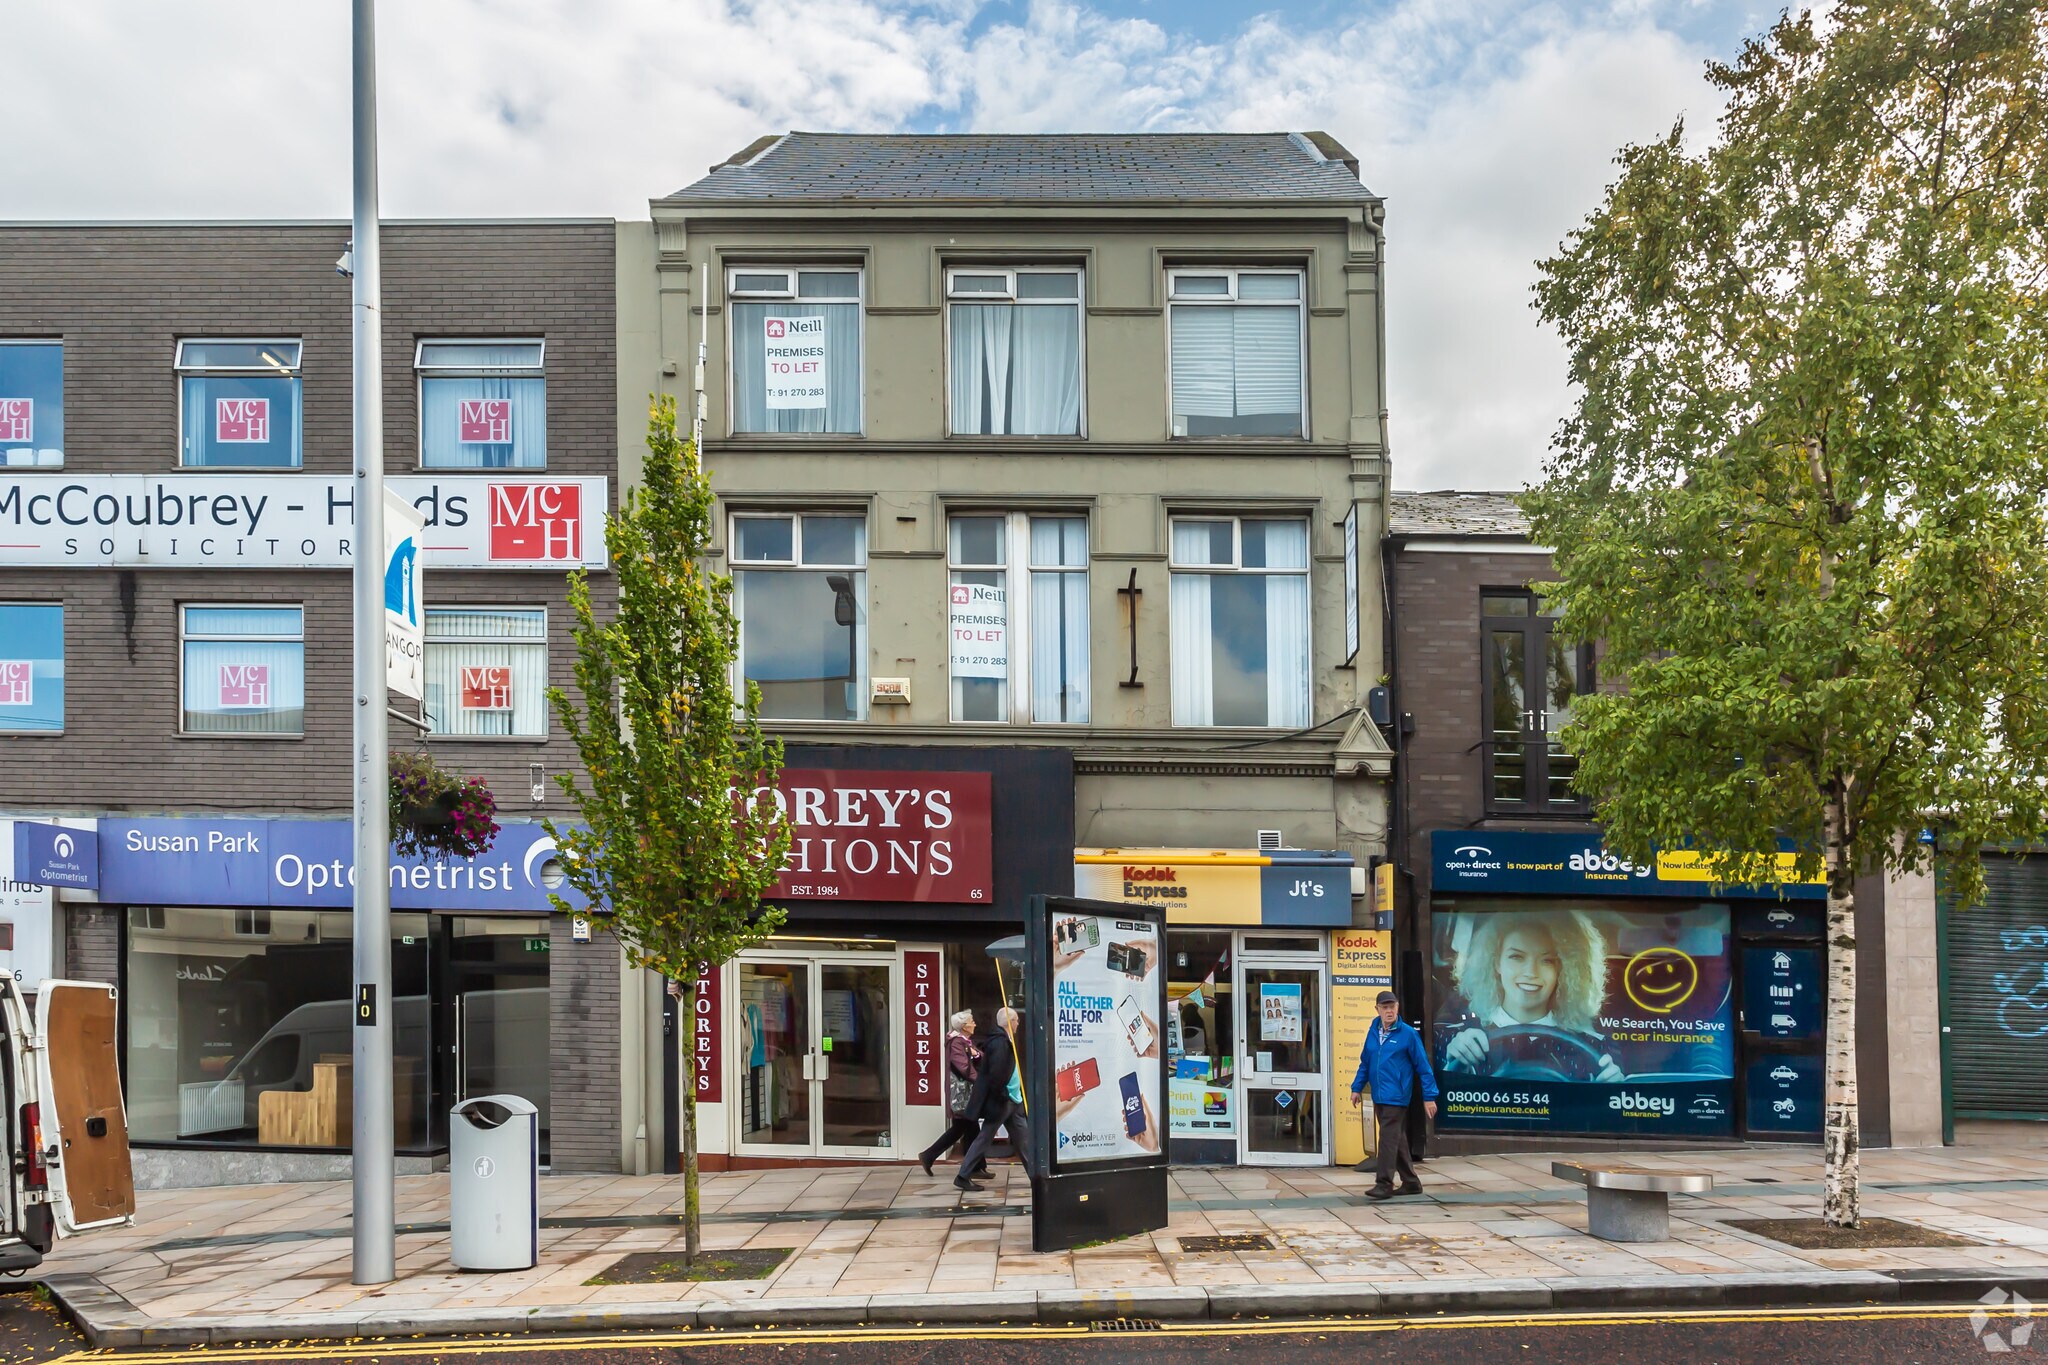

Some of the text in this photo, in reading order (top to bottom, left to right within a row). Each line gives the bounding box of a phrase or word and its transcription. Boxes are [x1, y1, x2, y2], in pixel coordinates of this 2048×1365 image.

[788, 320, 822, 333] Neill
[767, 347, 824, 357] PREMISES
[771, 362, 819, 374] TO LET
[767, 389, 776, 397] T:
[778, 389, 788, 397] 91
[809, 388, 824, 396] 283
[0, 485, 268, 535] McCoubrey
[327, 485, 468, 527] Hds
[65, 538, 353, 556] SOLICITOR
[973, 587, 1006, 602] Neill
[951, 614, 1006, 626] PREMISES
[954, 629, 1002, 641] TO LET
[385, 630, 422, 662] ANGOR
[960, 656, 970, 664] 91
[972, 656, 988, 664] 270
[990, 657, 1006, 666] 283
[127, 830, 260, 853] Susan Park
[48, 861, 80, 871] Susan Park
[1507, 861, 1515, 869] is
[1535, 863, 1549, 871] part
[1551, 862, 1564, 870] of
[41, 869, 88, 883] Optometrist
[275, 854, 513, 895] Optmetrist
[1123, 866, 1176, 881] Kodak
[1585, 872, 1628, 880] insurance
[791, 885, 839, 896] EST. 1984
[970, 889, 983, 899] 65
[1123, 882, 1188, 901] Express
[1289, 880, 1324, 898] Jt's
[1151, 901, 1188, 909] Solutions
[1336, 936, 1378, 949] Kodak
[1337, 949, 1387, 963] Express
[1337, 962, 1387, 970] Digital Solutions
[1336, 976, 1347, 984] Tel:
[1360, 977, 1375, 985] 9185
[1376, 977, 1390, 985] 7888
[1058, 981, 1078, 995] ALL
[1058, 995, 1113, 1009] TOGETHER
[1059, 1009, 1103, 1023] ALL FOR
[914, 963, 931, 1093] STOREYS
[1059, 1023, 1083, 1037] FREE
[1600, 1017, 1725, 1031] We Search, You Save
[1612, 1032, 1714, 1044] on car insurance
[1447, 1091, 1549, 1105] 08000 66 55 44
[1609, 1091, 1675, 1115] abbey
[1169, 1105, 1196, 1115] hare
[1447, 1103, 1550, 1115] abbeyinsurance.co.uk
[1622, 1110, 1660, 1118] insurance
